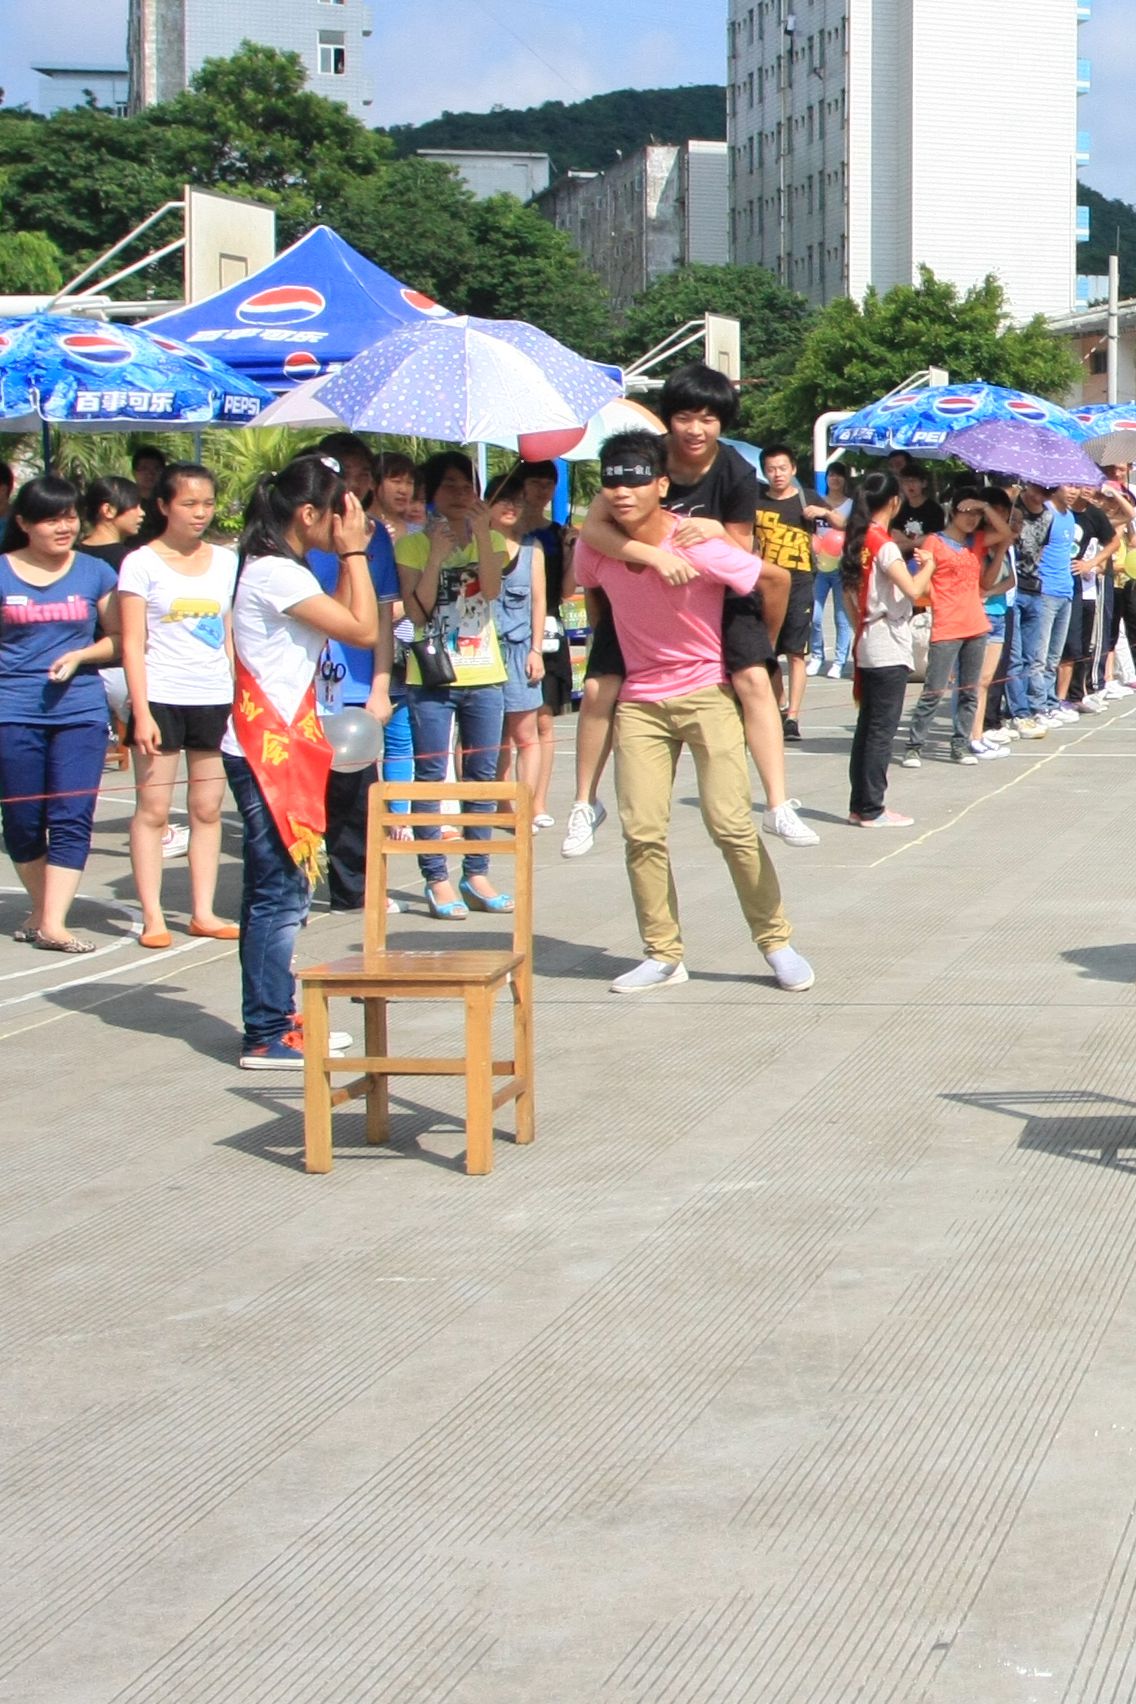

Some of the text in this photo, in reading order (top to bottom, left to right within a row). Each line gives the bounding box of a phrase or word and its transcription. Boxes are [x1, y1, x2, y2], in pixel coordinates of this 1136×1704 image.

[76, 390, 175, 413] 百事可乐
[223, 394, 260, 416] PEPSI
